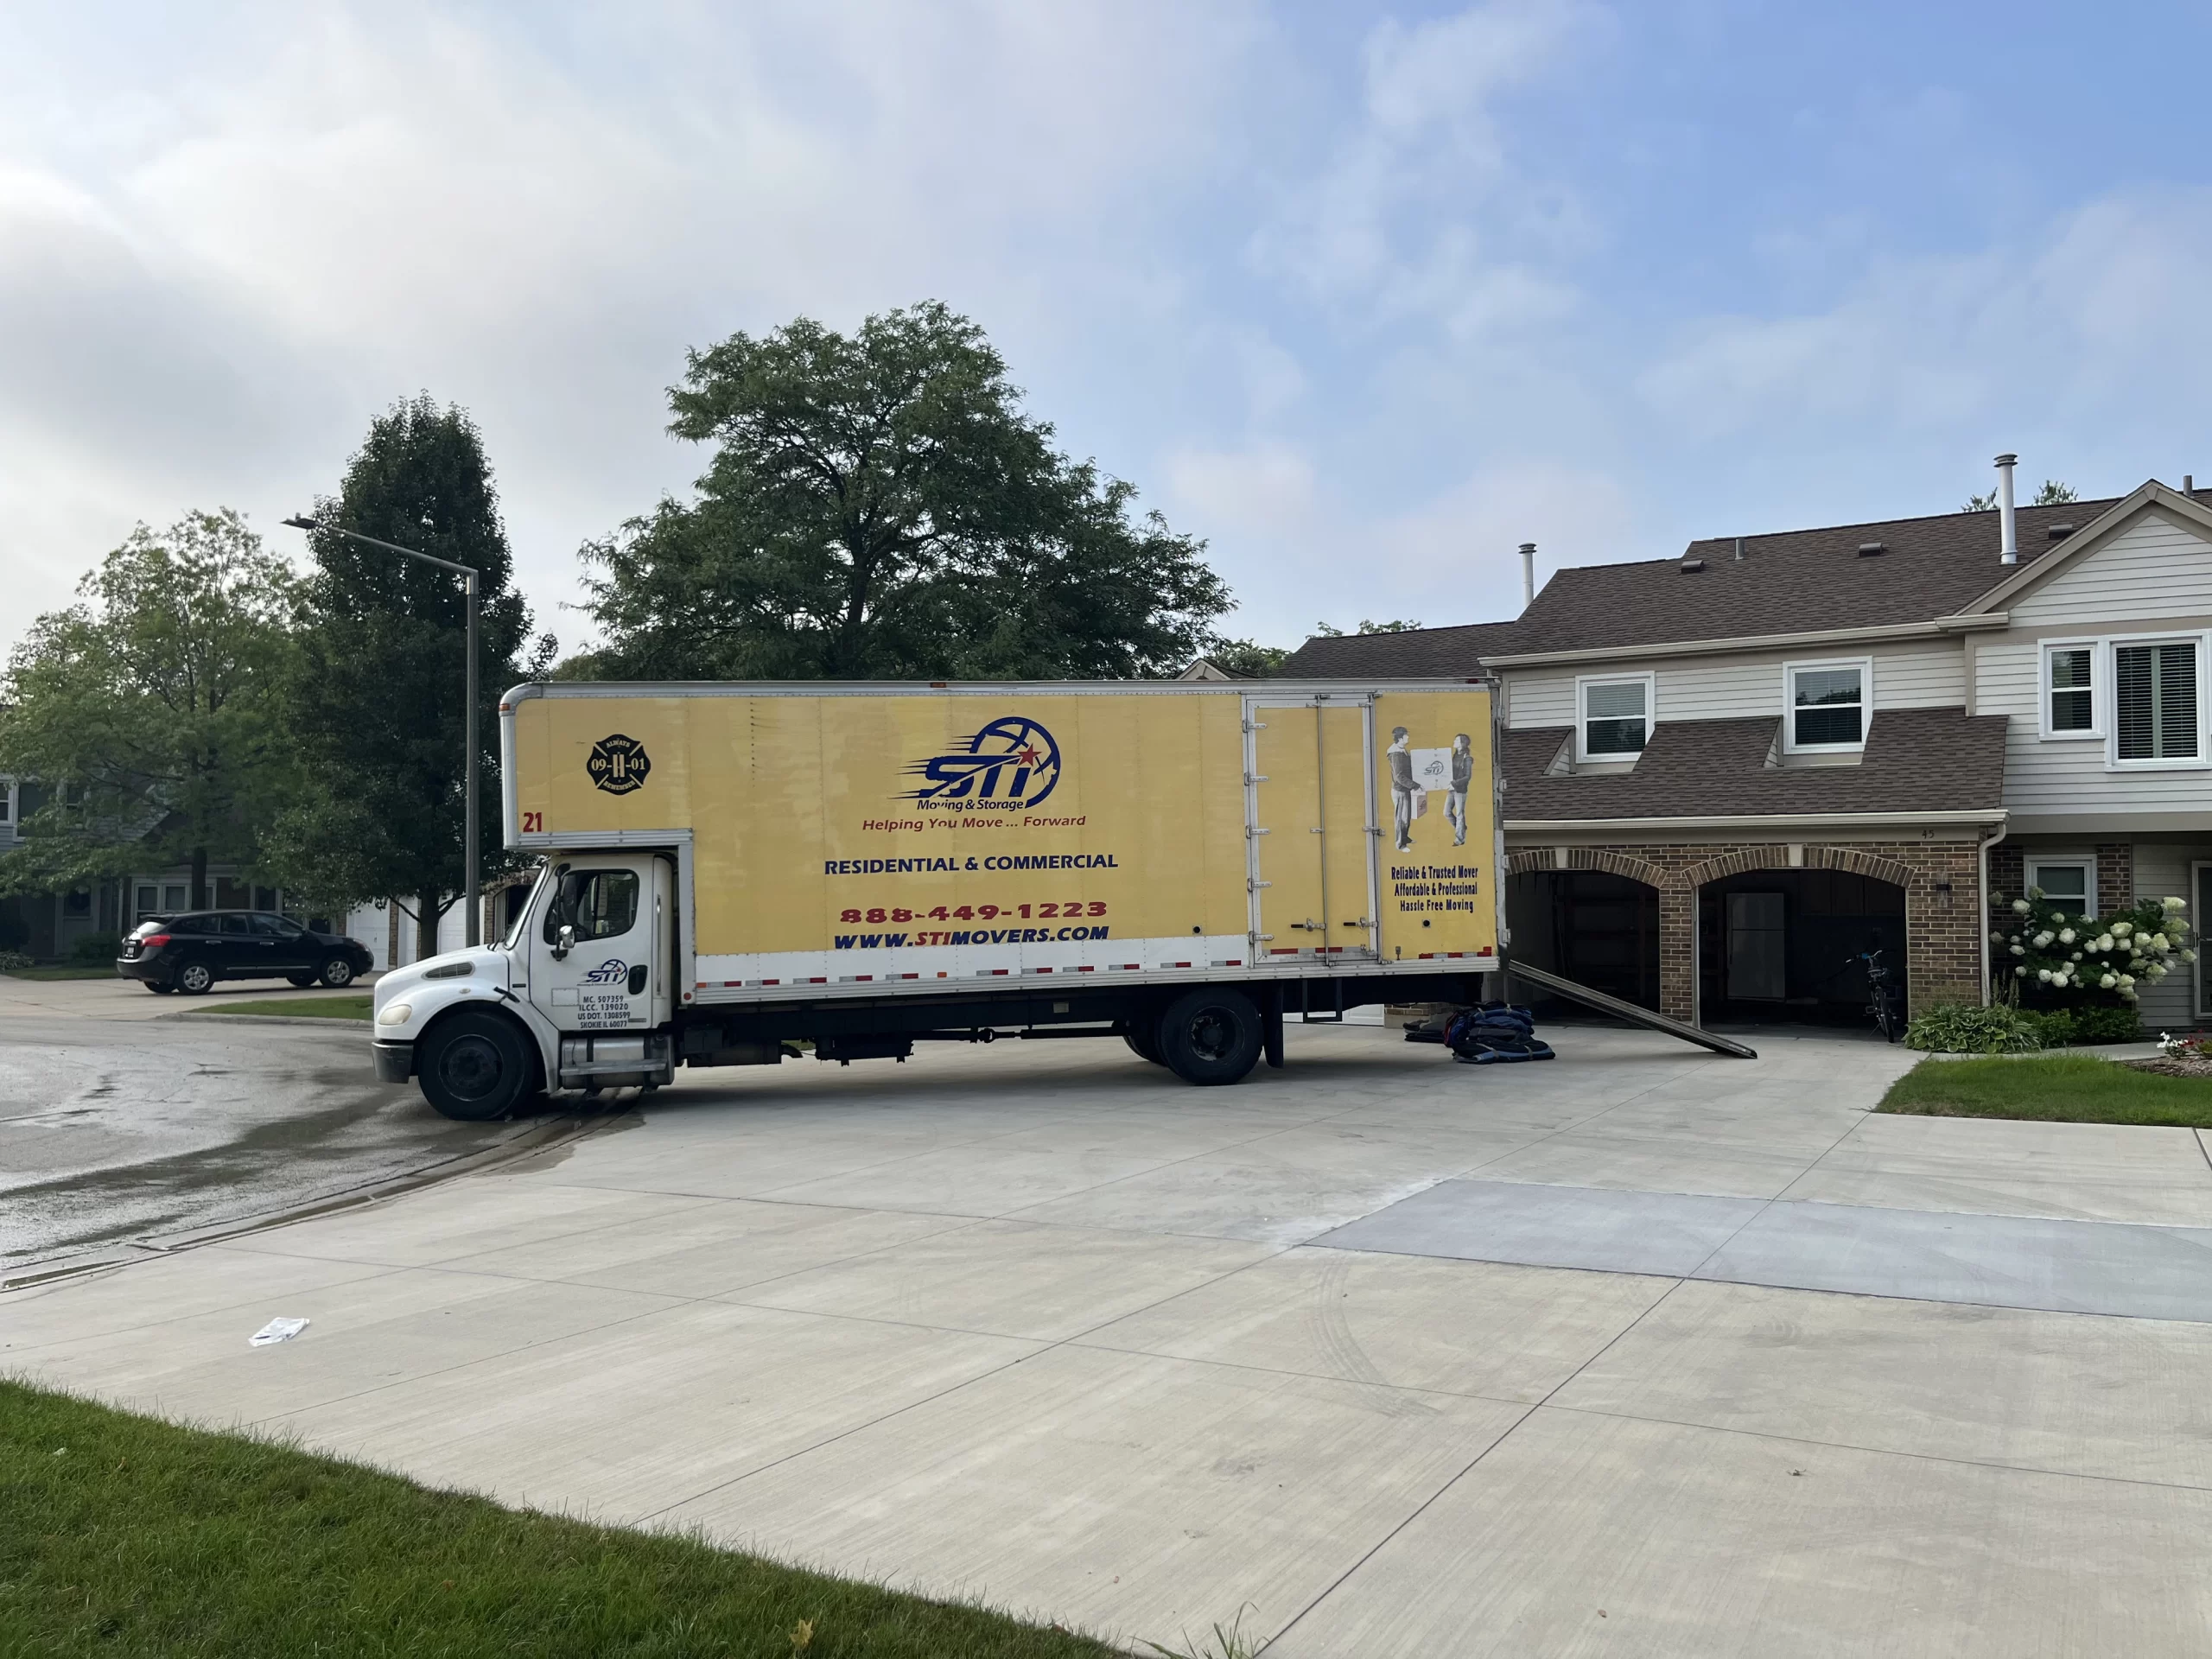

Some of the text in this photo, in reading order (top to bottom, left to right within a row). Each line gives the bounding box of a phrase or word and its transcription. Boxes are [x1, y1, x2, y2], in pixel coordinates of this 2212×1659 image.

[606, 740, 631, 748] ALWAYS
[917, 798, 1024, 812] Moving & Storage
[523, 812, 543, 832] 21
[862, 819, 924, 832] Helping
[929, 817, 957, 829] You
[1023, 816, 1086, 827] Forward
[1922, 830, 1935, 839] 45
[824, 855, 1118, 874] RESIDENTIAL & COMMERCIAL
[1391, 865, 1478, 880] Reliable & Trusted Mover
[1394, 881, 1478, 897] Affordable & Professional
[840, 901, 1107, 924] 888-449-1223
[1400, 899, 1473, 913] Hassle Free Moving
[835, 926, 1109, 950] WWW.STIMOVERS.COM
